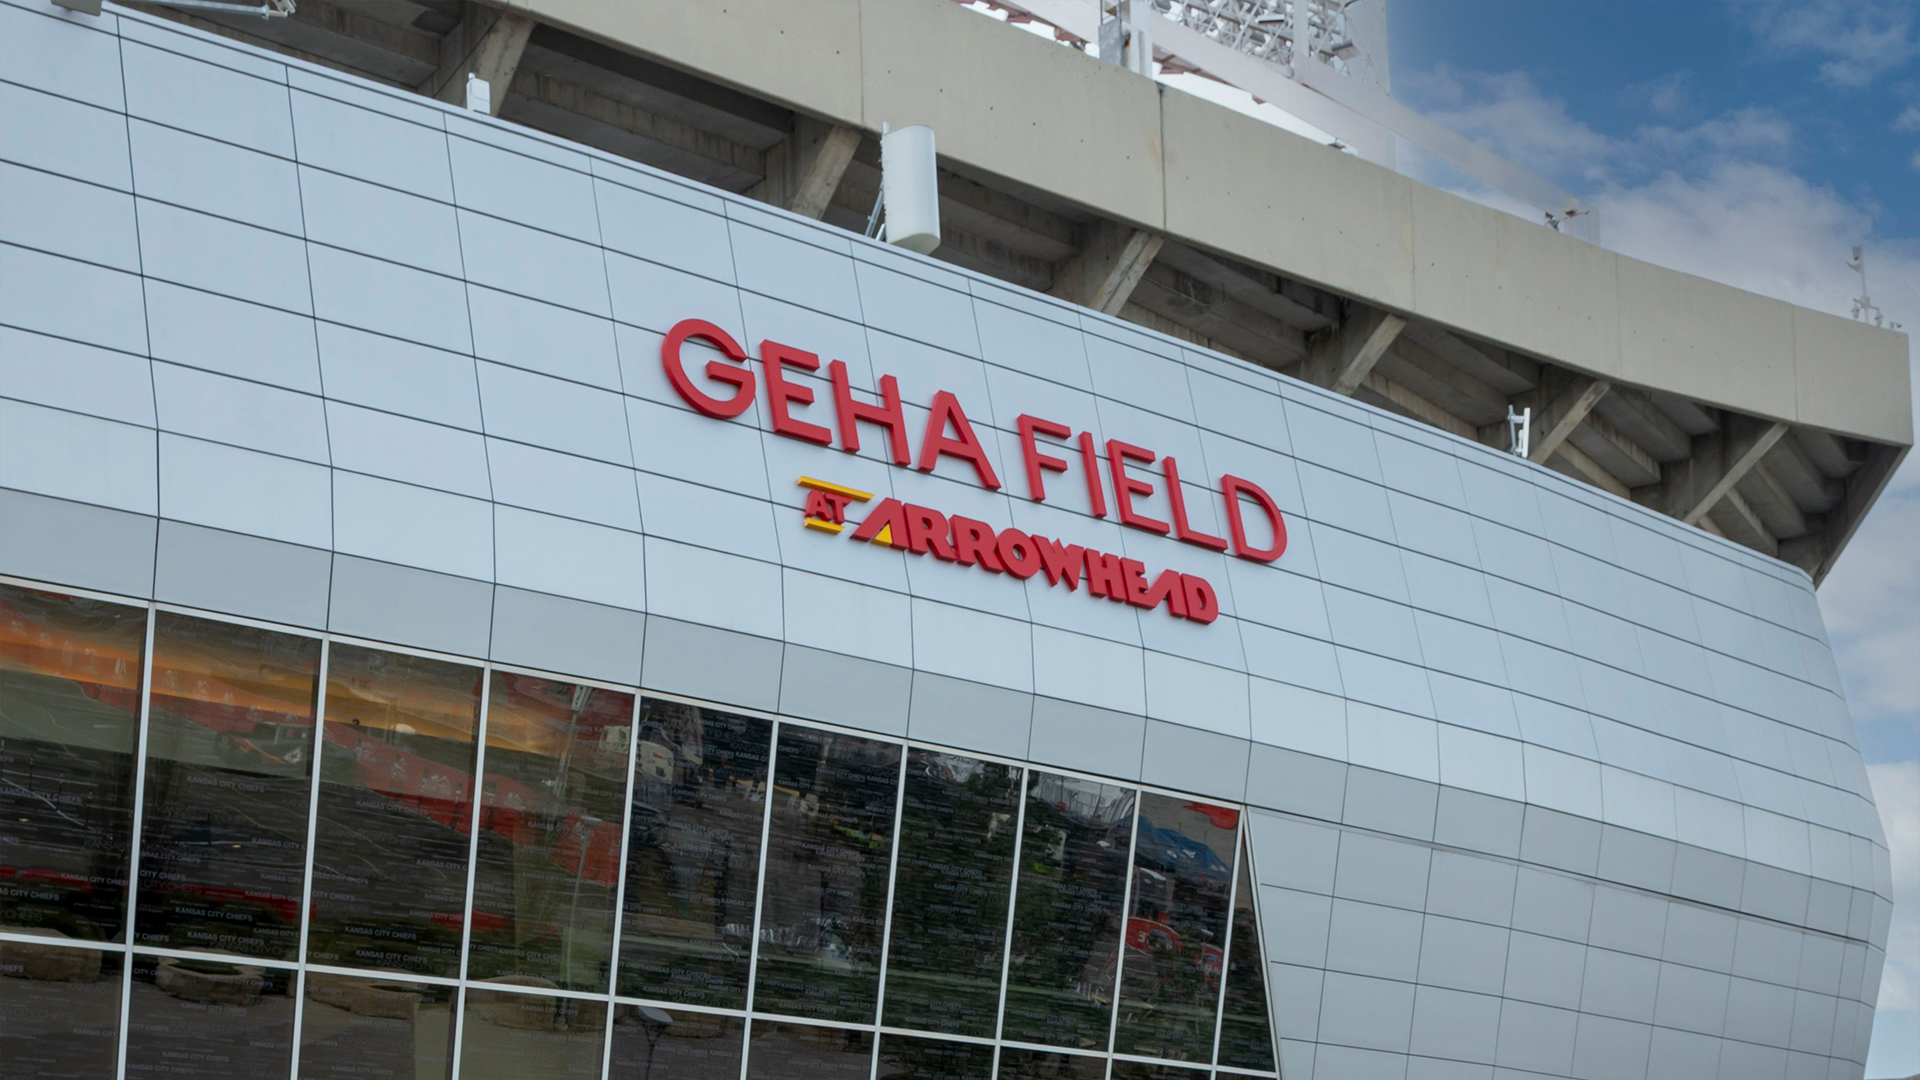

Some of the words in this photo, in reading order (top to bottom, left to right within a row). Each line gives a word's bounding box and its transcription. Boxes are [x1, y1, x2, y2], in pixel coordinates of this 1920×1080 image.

[661, 318, 1001, 490] GEHA
[1017, 413, 1288, 564] FIELD
[804, 488, 850, 525] AT
[850, 497, 1219, 626] ARROWHEAD
[187, 776, 218, 786] KANSAS
[219, 780, 237, 789] CITY
[238, 782, 265, 793] CHIEFS
[252, 838, 282, 848] KANSAS
[282, 841, 300, 850] CITY
[61, 872, 89, 882] KANSAS
[140, 870, 157, 879] CITY
[158, 872, 187, 881] CHIEFS
[10, 889, 28, 898] CITY
[30, 892, 60, 901] CHIEFS
[175, 906, 206, 917] KANSAS
[207, 910, 225, 919] CITY
[226, 912, 253, 922] CHIEFS
[142, 932, 170, 943] CHIEFS
[187, 931, 218, 942] KANSAS
[219, 934, 237, 944] CITY
[238, 936, 265, 946] CHIEFS
[253, 928, 279, 937] KANSAS
[280, 930, 295, 938] CITY
[344, 926, 373, 935] KANSAS
[374, 929, 391, 937] CITY
[392, 931, 417, 941] CHIEFS
[417, 945, 441, 954] KANSAS
[356, 950, 384, 959] KANSAS
[386, 952, 401, 961] CITY
[402, 954, 428, 963] CHIEFS
